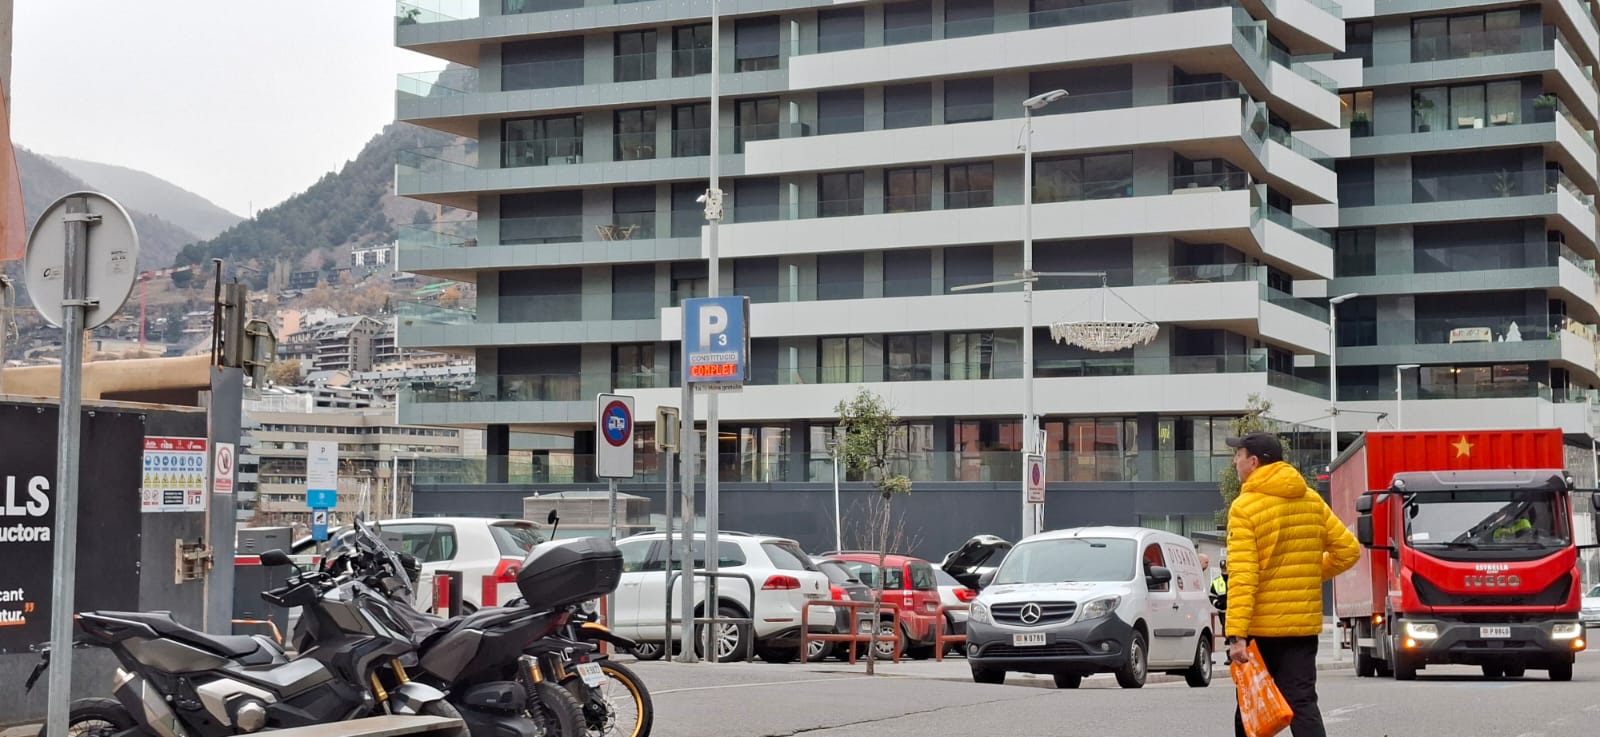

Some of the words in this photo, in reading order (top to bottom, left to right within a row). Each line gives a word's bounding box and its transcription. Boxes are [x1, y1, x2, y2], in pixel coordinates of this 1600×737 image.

[700, 306, 728, 348] P
[719, 334, 727, 345] 3
[690, 364, 736, 376] COMPLET
[1465, 575, 1520, 587] IVECO
